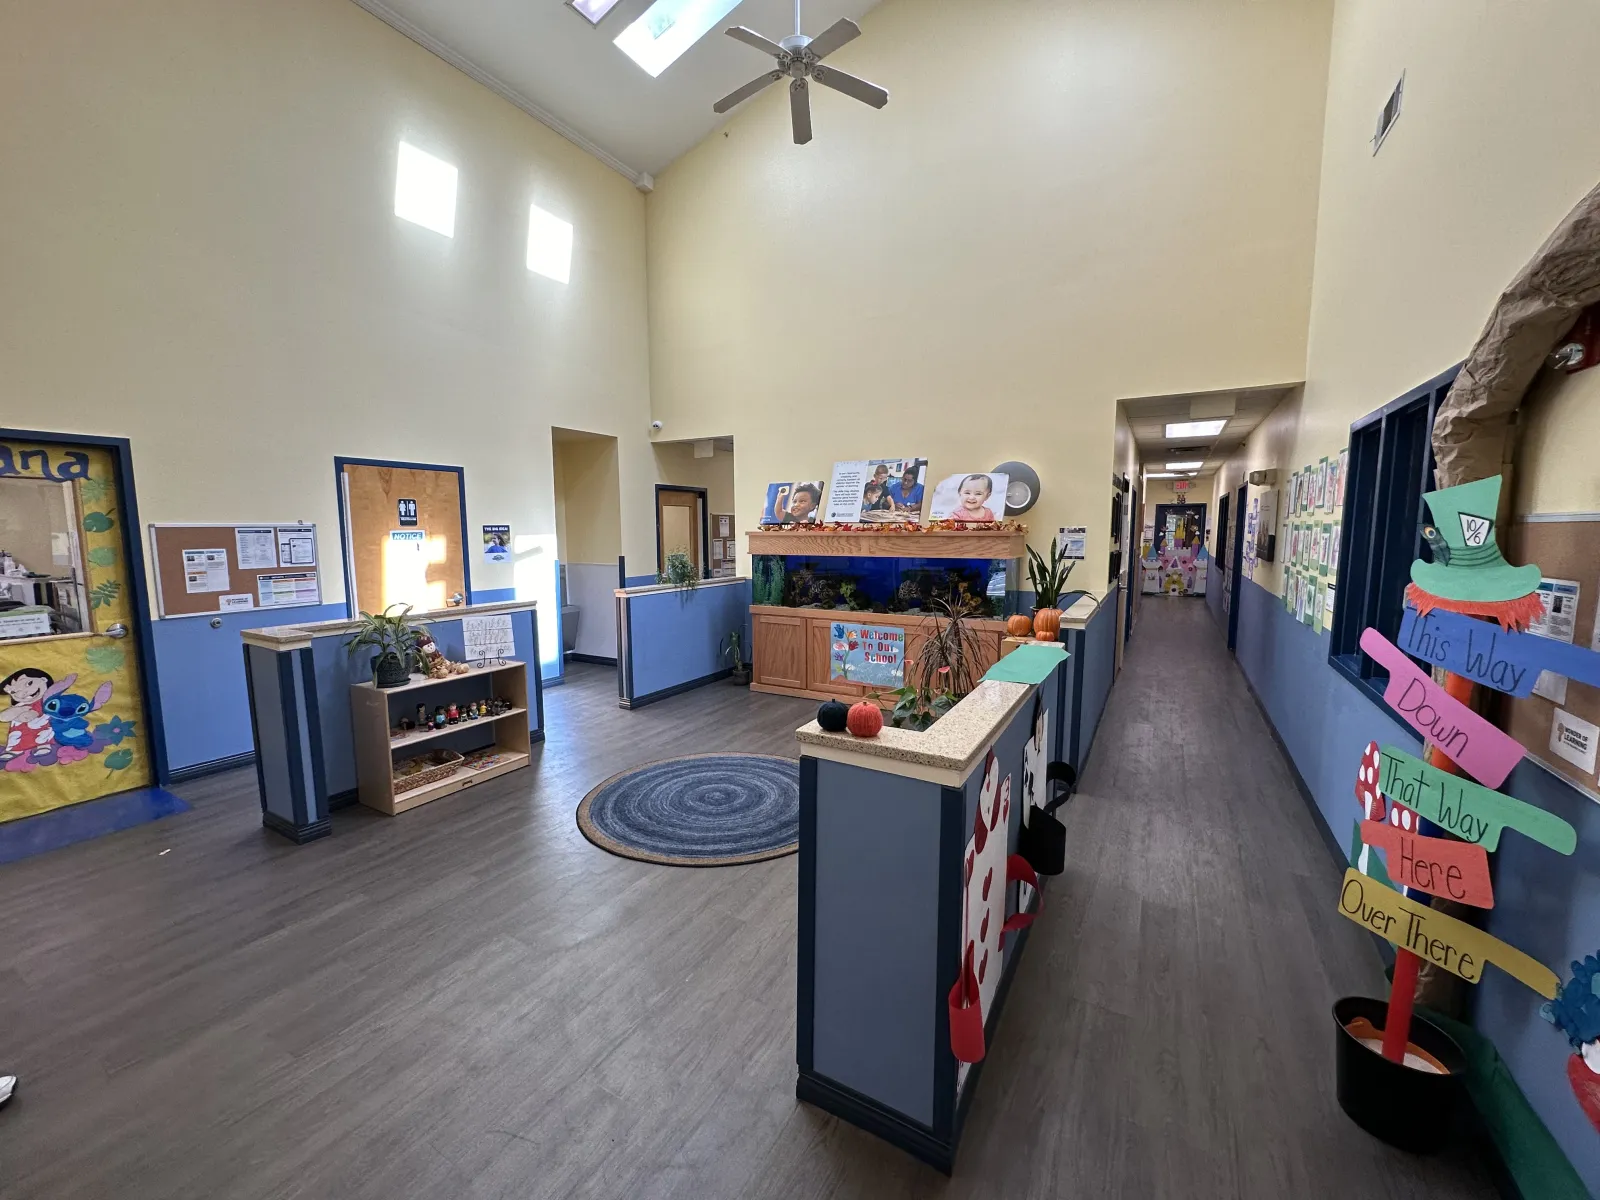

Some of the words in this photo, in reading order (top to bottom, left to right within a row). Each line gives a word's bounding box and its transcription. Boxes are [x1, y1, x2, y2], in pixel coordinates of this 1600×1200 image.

[860, 629, 904, 642] Welcome
[862, 641, 873, 651] To
[878, 641, 894, 653] Our
[864, 652, 897, 664] School
[1406, 605, 1450, 661] This
[1466, 629, 1526, 692] Way
[1397, 677, 1469, 758] Down
[1564, 733, 1588, 750] LEARNING
[1381, 751, 1430, 810] That
[1437, 781, 1488, 844] Way
[1400, 836, 1466, 899] Here
[1341, 879, 1396, 934] Over
[1399, 906, 1475, 981] There
